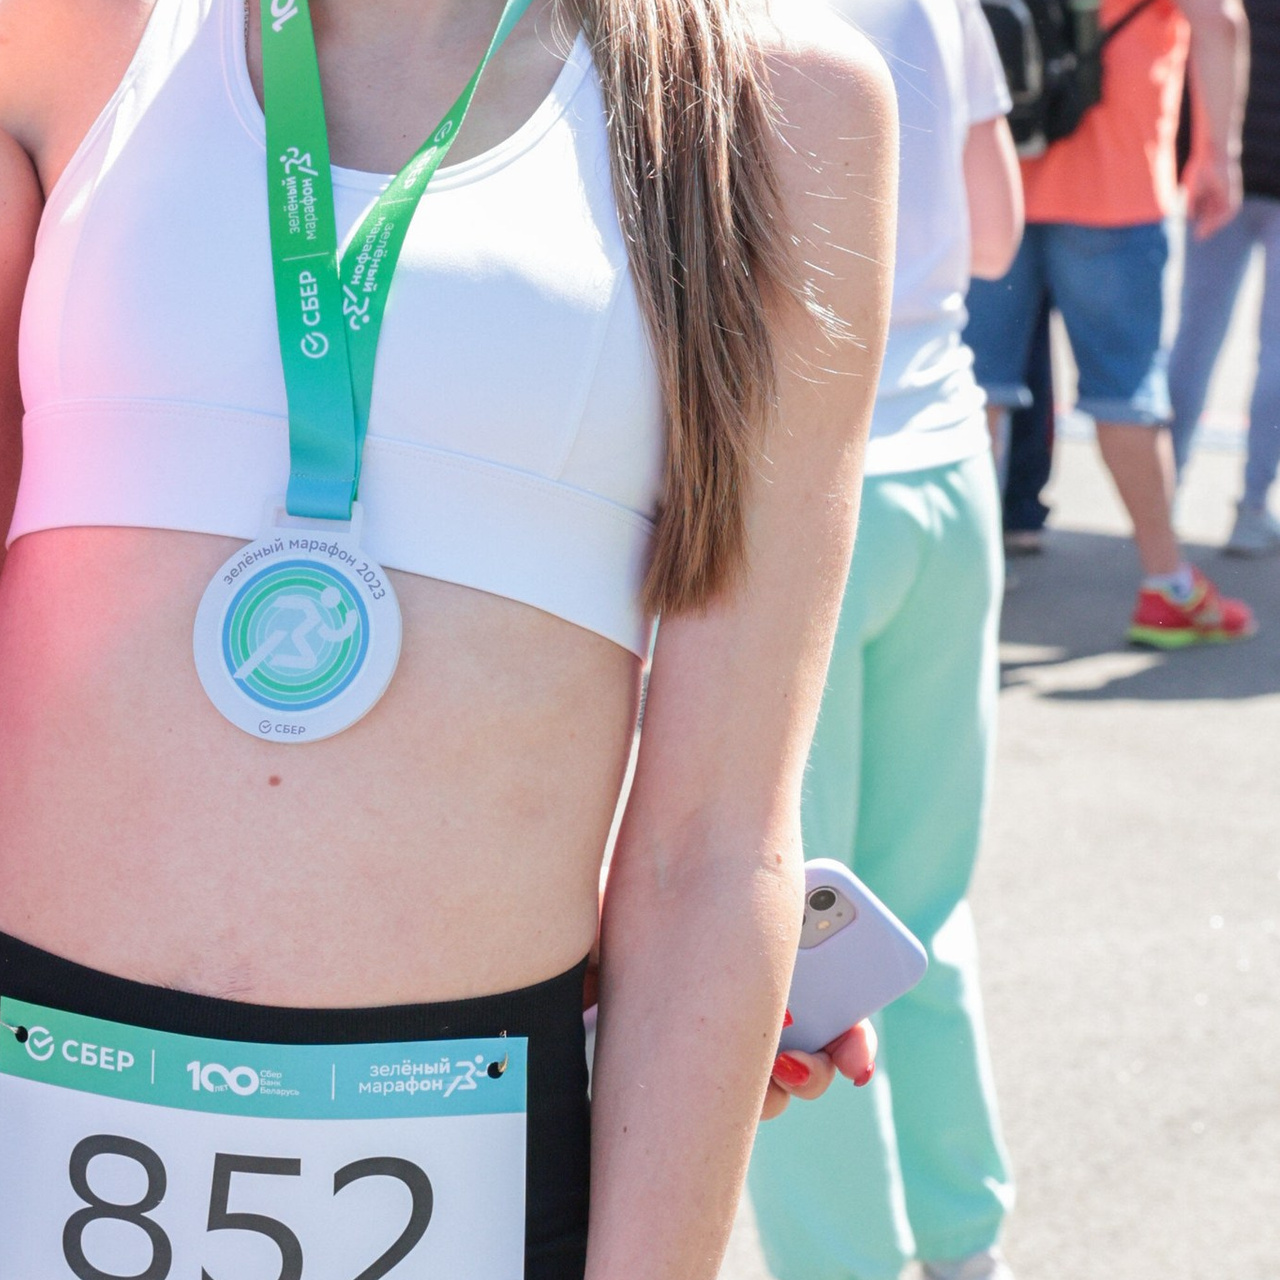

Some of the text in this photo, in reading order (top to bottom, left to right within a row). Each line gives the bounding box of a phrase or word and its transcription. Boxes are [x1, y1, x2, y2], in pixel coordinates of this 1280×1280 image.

[281, 176, 300, 234] зелёный
[299, 178, 317, 240] марафон
[351, 216, 385, 285] марафон
[362, 223, 394, 292] зелёный
[300, 271, 320, 326] СБЕР
[223, 538, 386, 600] зелёный марафон 2023
[275, 724, 306, 735] СБЕР
[62, 1039, 135, 1072] СБЕР
[370, 1058, 451, 1077] зелёный
[187, 1060, 259, 1096] 100
[260, 1070, 282, 1079] Сбер
[260, 1078, 281, 1087] Банк
[260, 1087, 300, 1096] Беларусь
[359, 1076, 443, 1096] марафон
